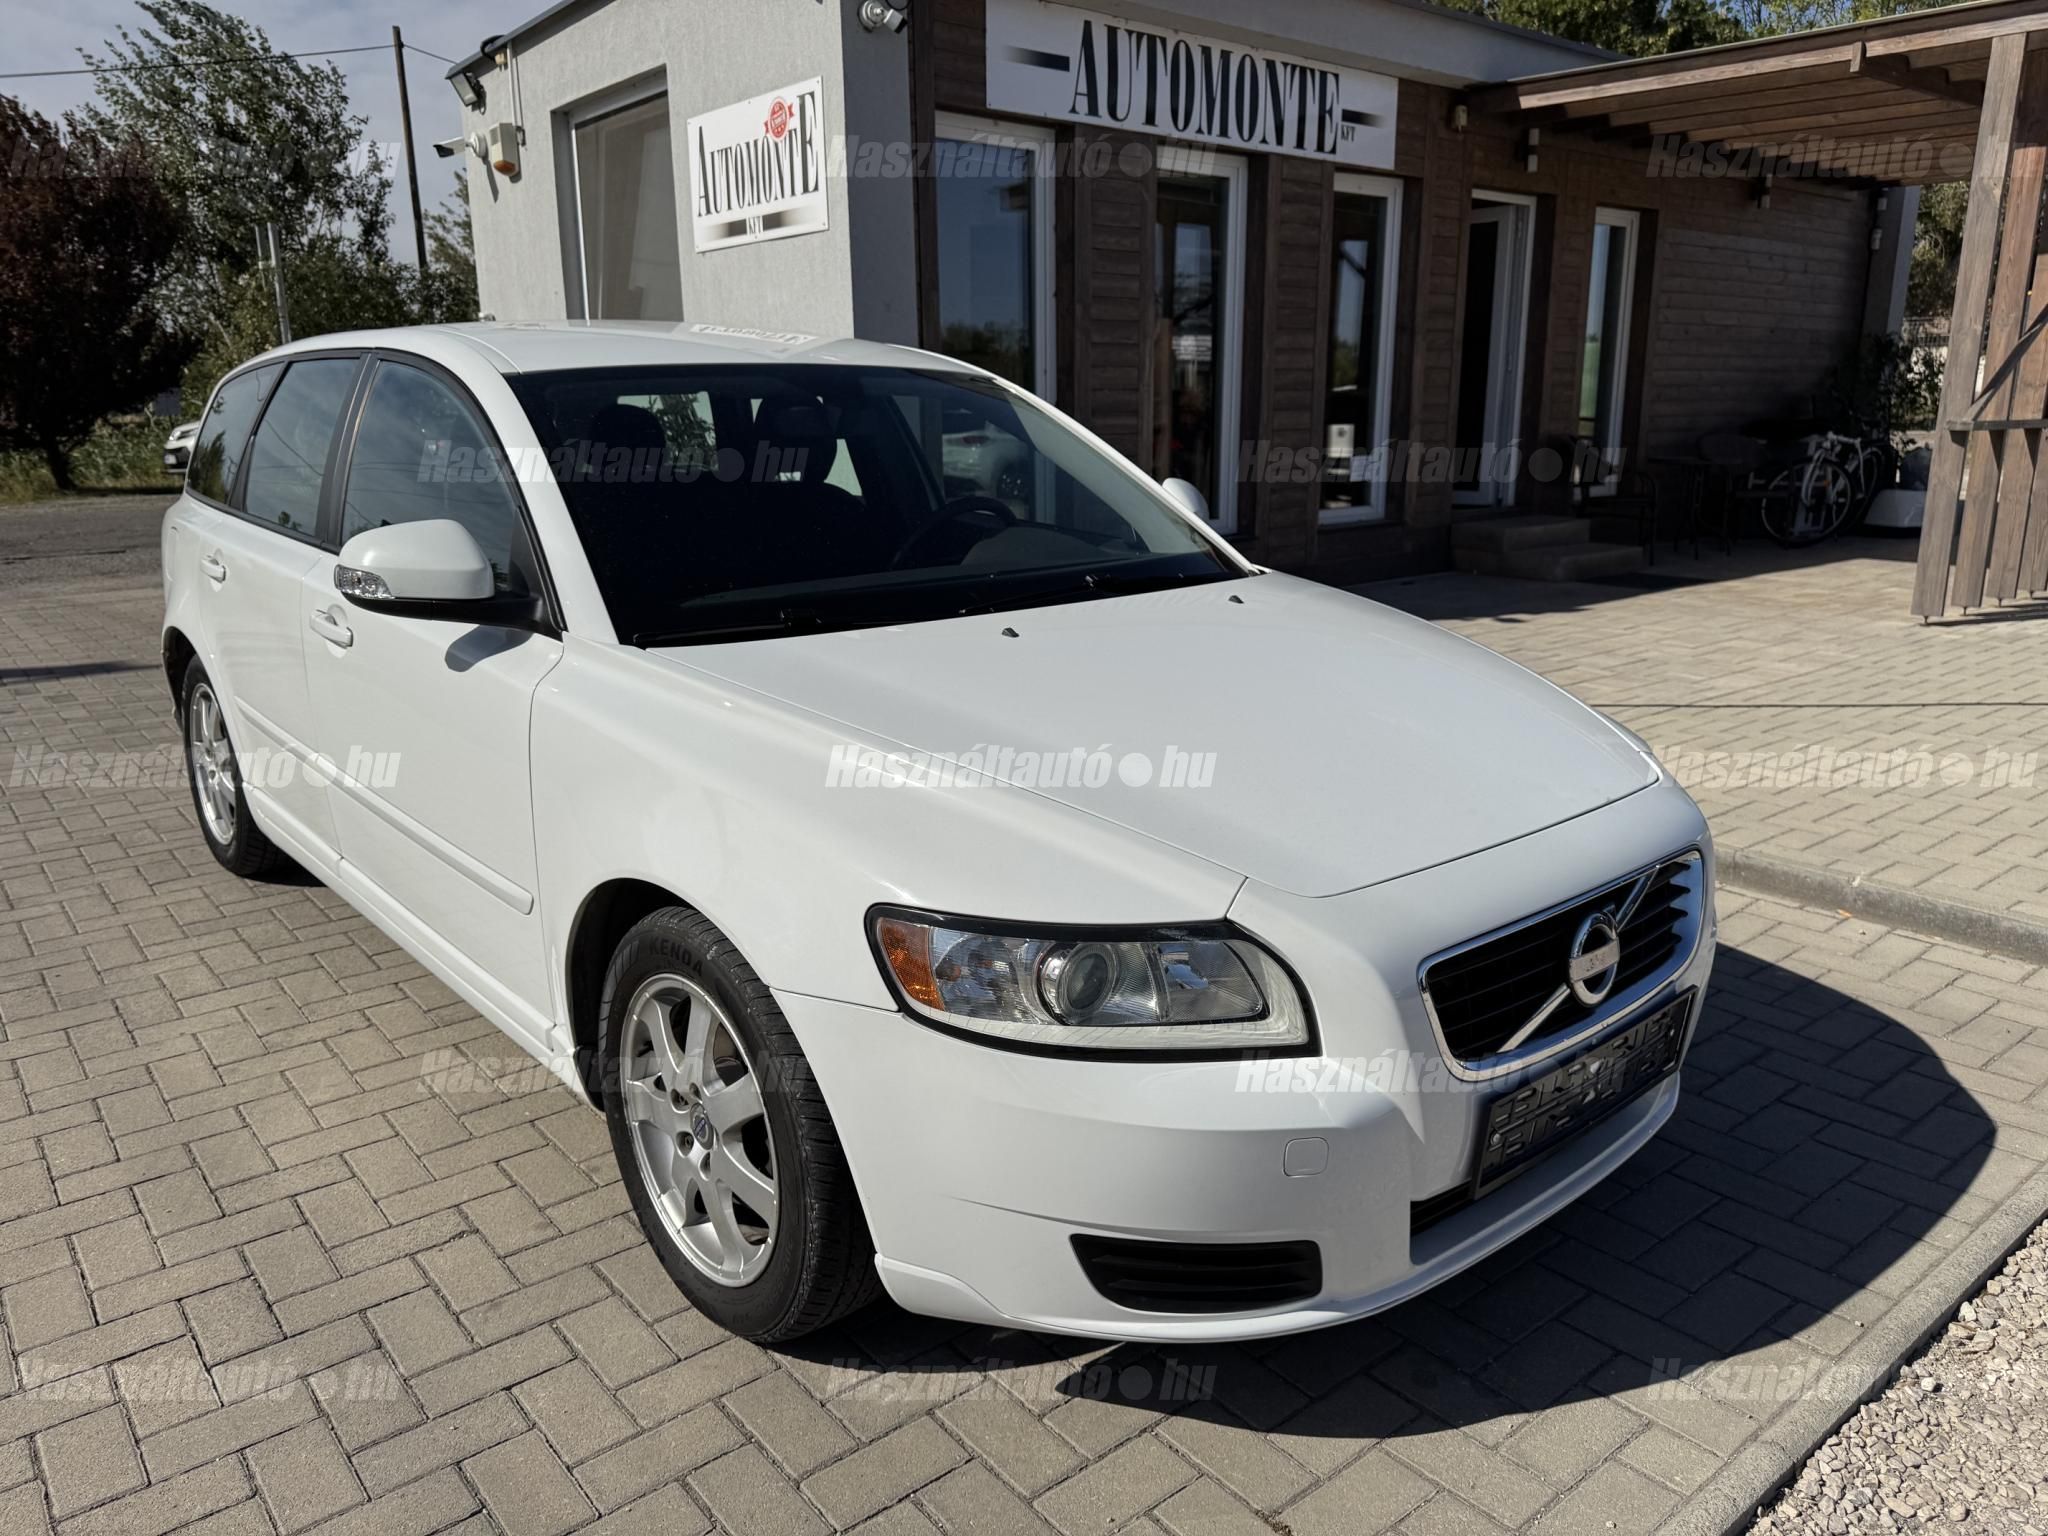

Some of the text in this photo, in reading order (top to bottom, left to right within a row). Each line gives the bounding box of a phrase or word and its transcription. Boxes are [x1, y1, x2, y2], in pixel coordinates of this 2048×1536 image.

[1068, 20, 1340, 155] AUTOMONTE
[697, 91, 819, 217] AUTOMONTE
[649, 936, 703, 977] KENDA
